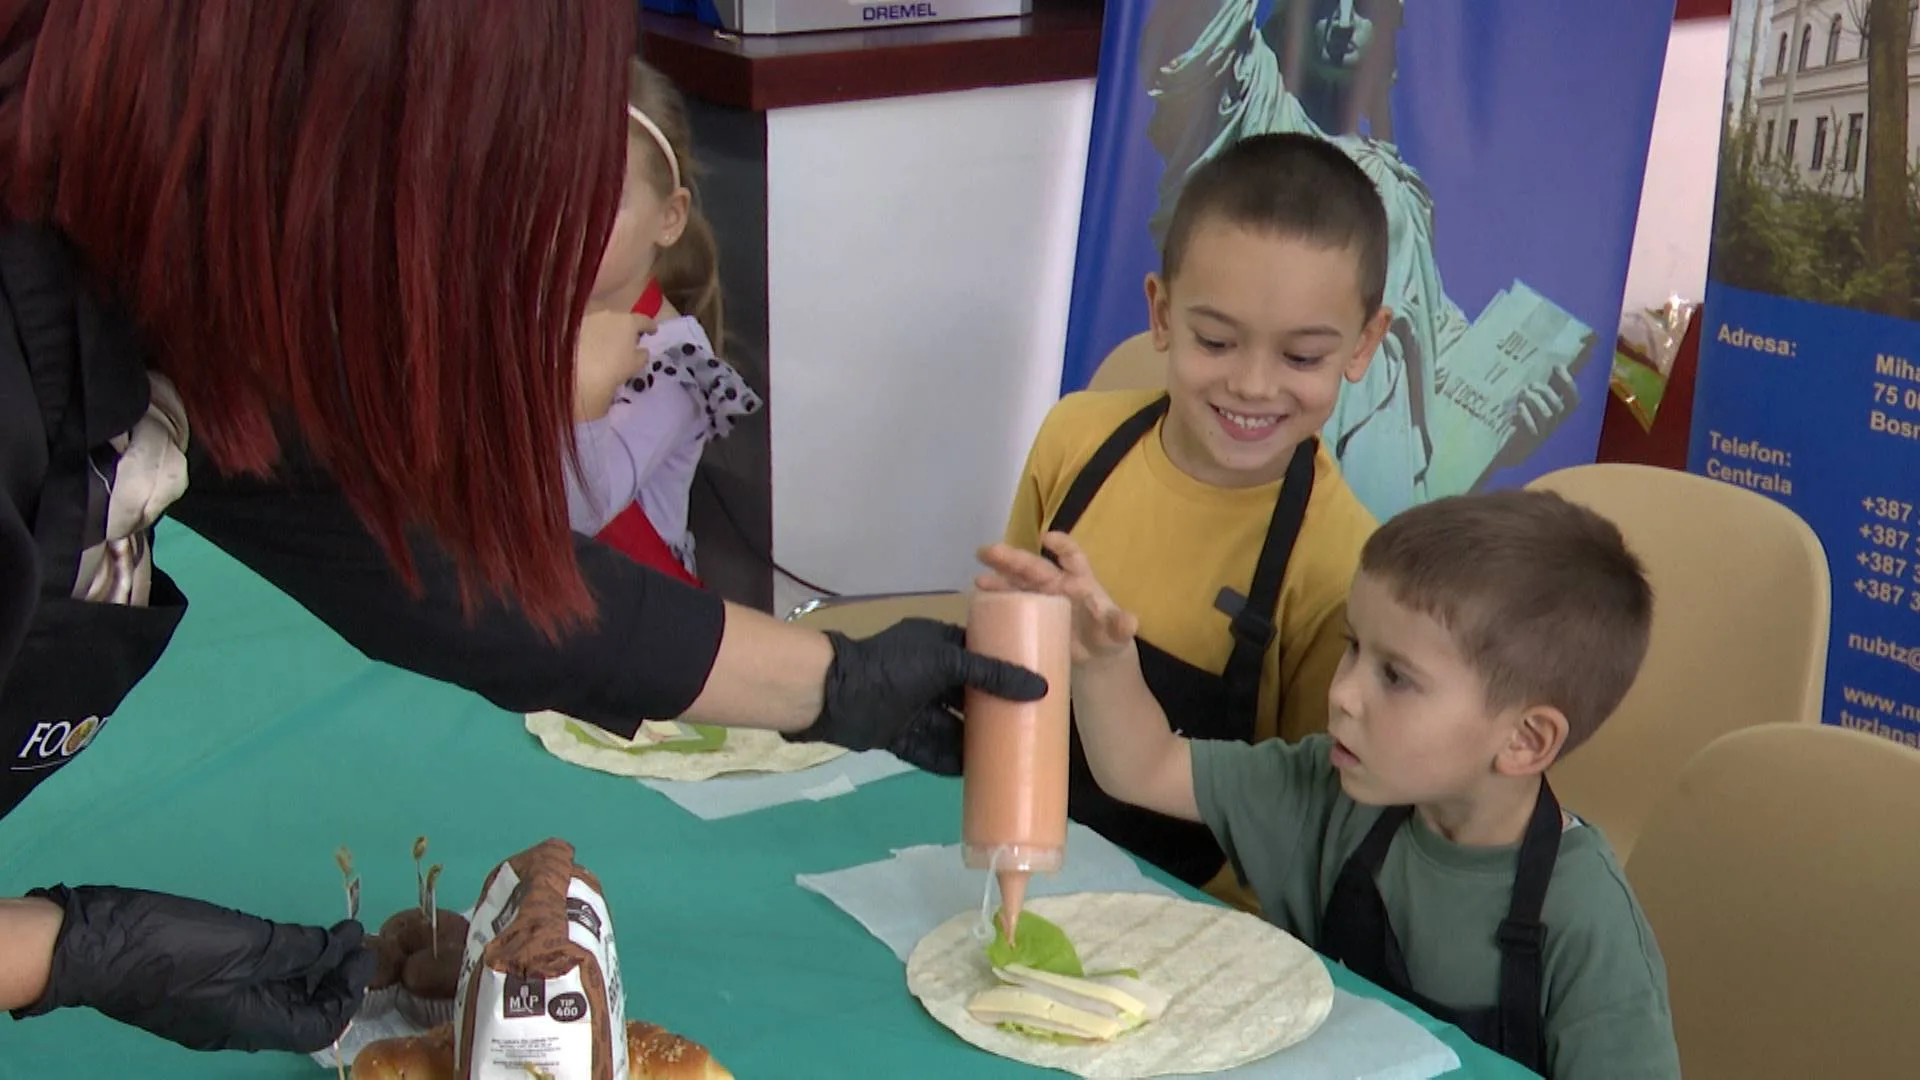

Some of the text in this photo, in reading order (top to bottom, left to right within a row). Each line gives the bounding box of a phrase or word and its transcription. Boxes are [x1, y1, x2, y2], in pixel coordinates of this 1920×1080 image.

[863, 3, 937, 20] DREMEL
[1717, 323, 1797, 358] Adresa:
[1873, 382, 1920, 412] 75 0
[1709, 430, 1792, 467] Telefon:
[1706, 457, 1792, 496] Centrala
[1862, 496, 1912, 523] +387
[1859, 524, 1910, 551] +387
[1856, 551, 1907, 579] +387
[1854, 578, 1904, 605] +387
[556, 1007, 578, 1017] 400
[559, 998, 576, 1007] TIP
